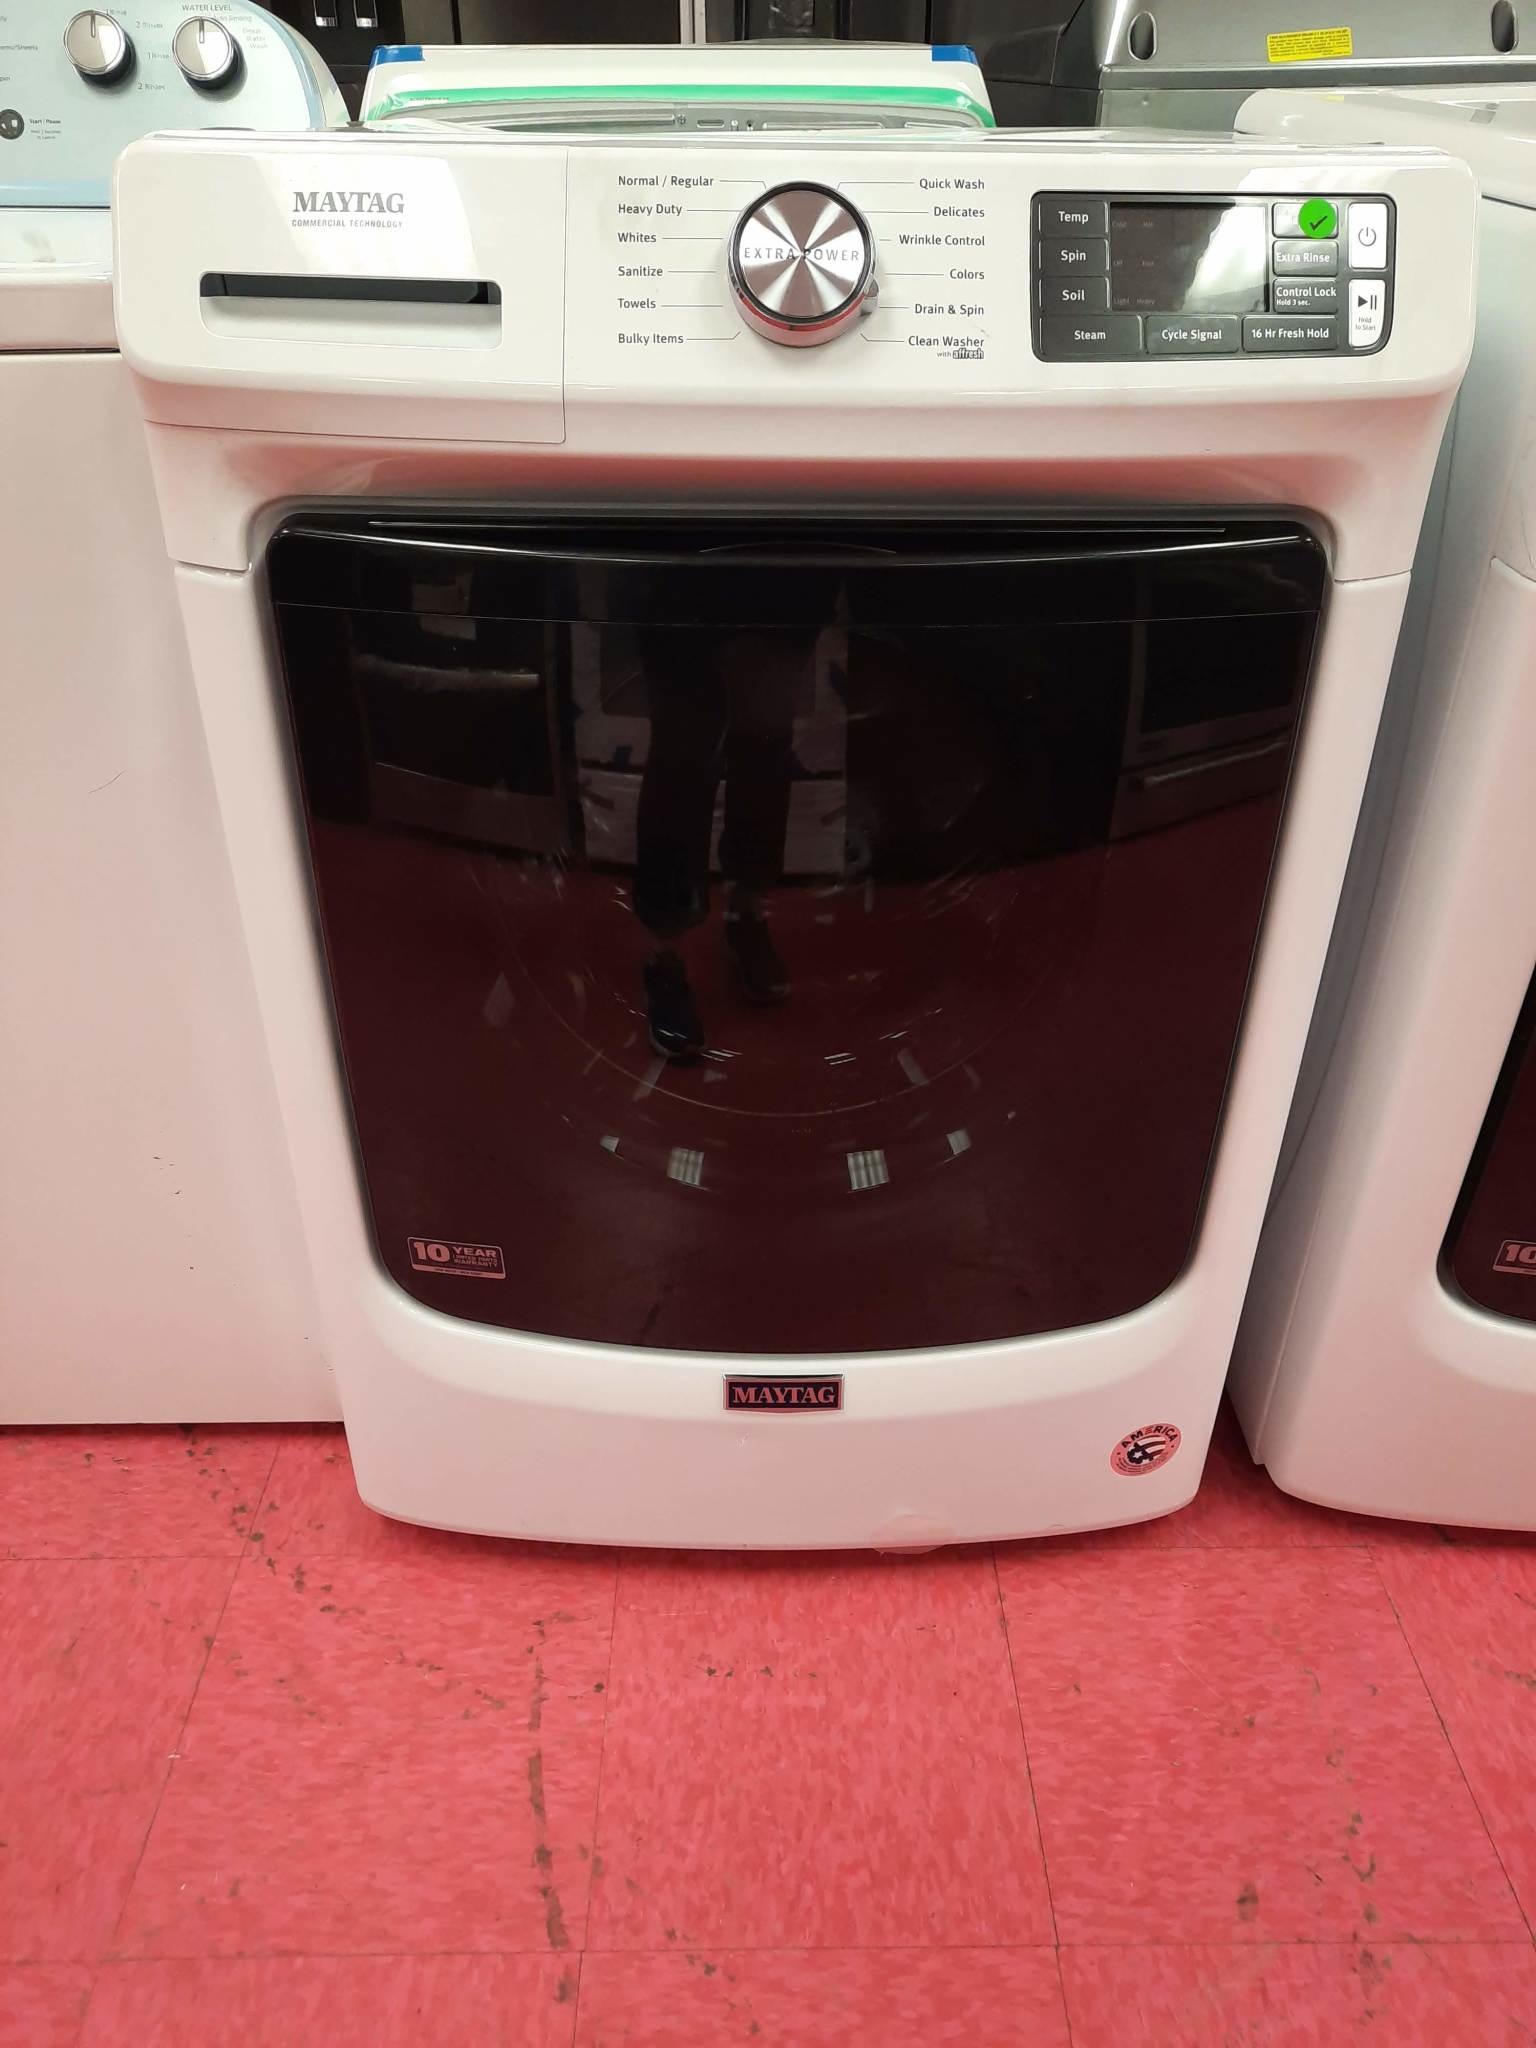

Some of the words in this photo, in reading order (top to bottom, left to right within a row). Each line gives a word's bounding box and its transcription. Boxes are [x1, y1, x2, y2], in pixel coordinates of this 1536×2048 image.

[618, 175, 659, 186] Normal
[670, 175, 714, 189] Regular
[919, 177, 948, 190] Quick
[950, 178, 985, 190] Wash
[293, 191, 405, 213] MAYTAG
[618, 203, 653, 217] Heavy
[656, 203, 683, 217] Duty
[933, 206, 985, 218] Delicates
[292, 219, 346, 227] COMMERCIAL
[350, 220, 403, 228] TECHNOLOGY
[1058, 210, 1089, 225] Temp
[617, 231, 657, 243] Whites
[899, 234, 941, 246] Wrinkle
[944, 235, 985, 247] Control
[744, 247, 796, 260] EXTRA
[803, 248, 860, 261] POWER
[1060, 249, 1087, 264] Spin
[1276, 252, 1300, 263] Extra
[1303, 252, 1330, 263] Rinse
[618, 265, 663, 277] Sanitize
[949, 268, 985, 280] Colors
[1062, 289, 1085, 301] Soil
[1276, 287, 1312, 297] Control
[1314, 287, 1337, 298] Lock
[617, 297, 657, 309] Towels
[914, 303, 945, 315] Drain
[948, 304, 957, 315] &
[959, 303, 985, 318] Spin
[618, 332, 650, 347] Bulky
[653, 332, 684, 344] Items
[1074, 329, 1107, 341] Steam
[1161, 328, 1188, 342] Cycle
[1190, 328, 1222, 342] Signal
[1251, 328, 1262, 339] 16
[1265, 328, 1276, 339] Hr
[1278, 328, 1304, 339] Fresh
[1307, 328, 1330, 339] Hold
[908, 335, 939, 346] Clean
[942, 335, 985, 346] Washer
[413, 1241, 450, 1262] 10
[452, 1246, 497, 1257] YEAR
[732, 1387, 835, 1403] MAYTAG
